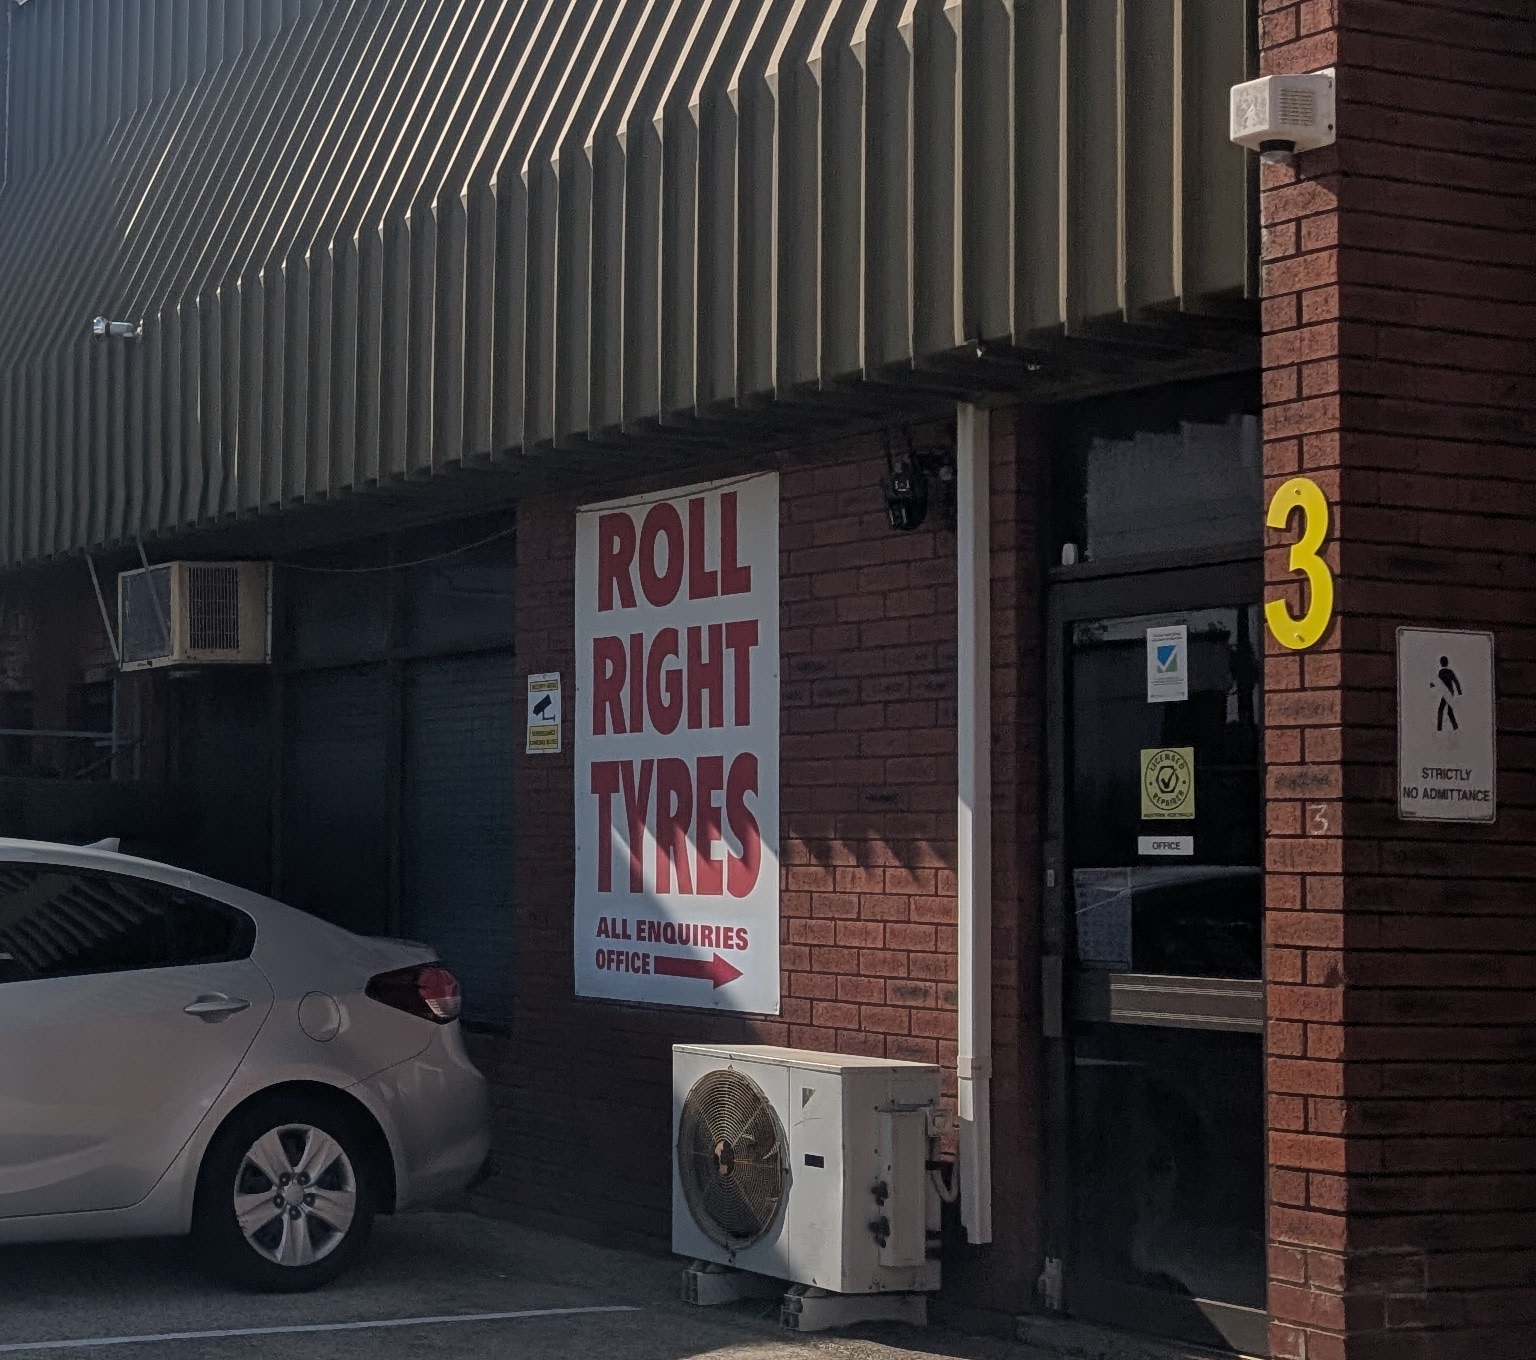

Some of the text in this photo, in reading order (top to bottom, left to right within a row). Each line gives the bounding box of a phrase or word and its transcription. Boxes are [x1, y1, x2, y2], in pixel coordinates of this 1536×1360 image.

[597, 490, 752, 613] ROLL
[1264, 476, 1335, 650] 3
[592, 618, 759, 736] RIGHT
[1148, 753, 1186, 772] LICENSED
[1421, 767, 1473, 781] STRICTLY
[1402, 786, 1491, 801] NO ADMITTANCE
[590, 751, 762, 899] TYRES
[1151, 841, 1182, 851] OFFICE
[595, 916, 750, 951] ALL ENQUIRIES
[595, 948, 651, 975] OFFICE
